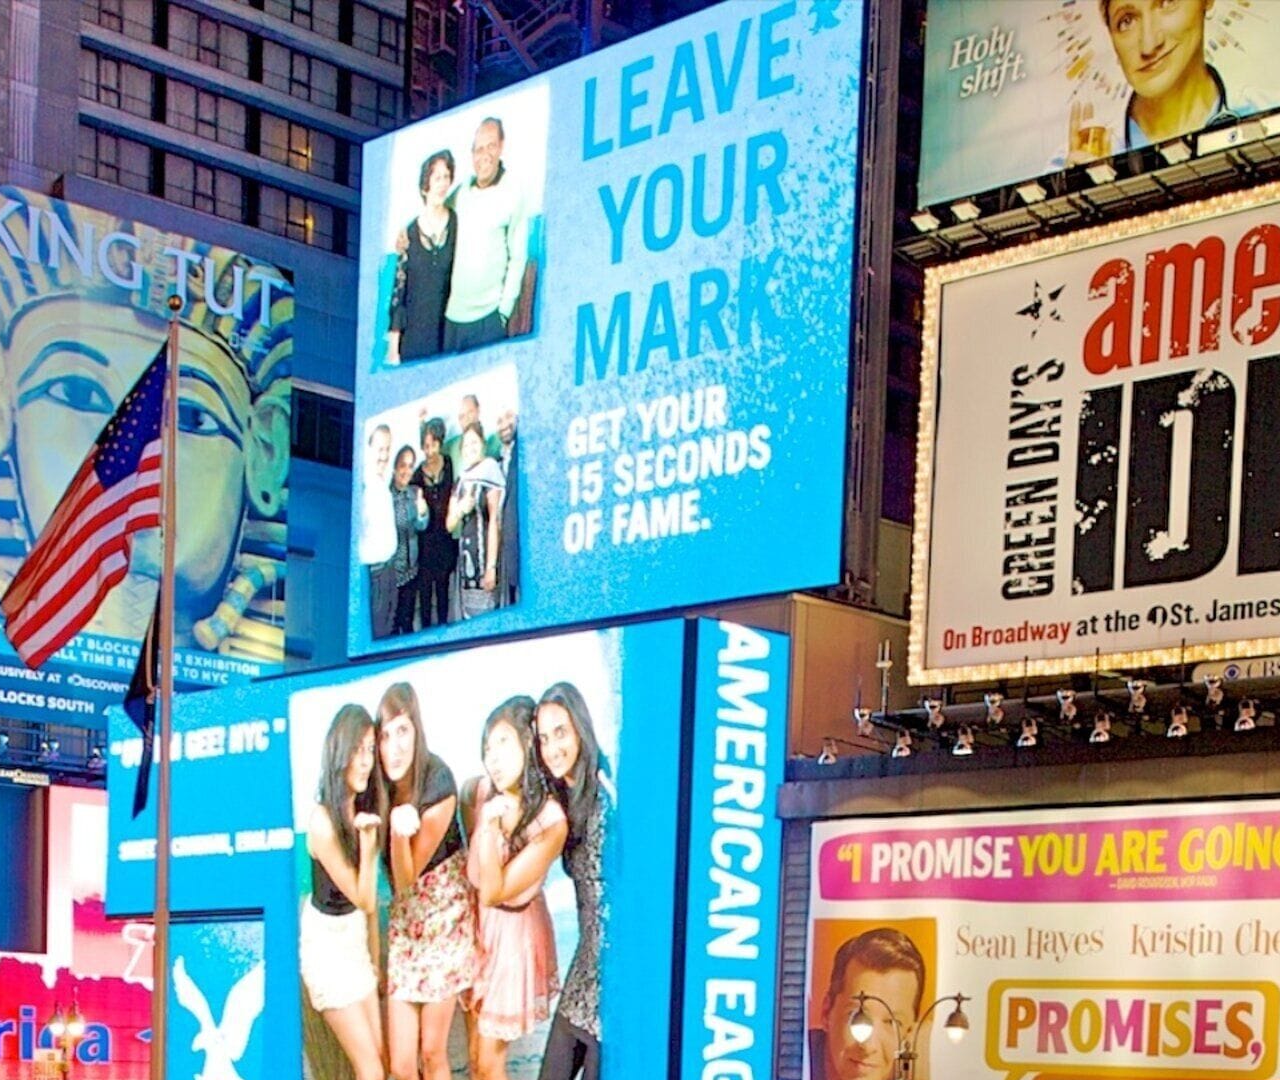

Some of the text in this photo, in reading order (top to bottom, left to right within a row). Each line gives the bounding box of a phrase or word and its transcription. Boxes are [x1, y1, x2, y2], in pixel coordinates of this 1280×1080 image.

[948, 25, 1015, 71] Holy
[960, 51, 1027, 99] shift.
[598, 129, 791, 266] YOUR
[162, 246, 295, 328] TUT
[573, 256, 778, 388] MARK
[566, 384, 730, 461] GET YOUR
[565, 425, 772, 508] 15 SECONDS
[1001, 357, 1066, 602] GREEN DAY'S
[563, 488, 711, 556] OF FAME.
[943, 628, 967, 651] On
[970, 621, 1072, 648] Broadway
[1076, 614, 1099, 637] at
[1104, 609, 1141, 633] the
[1170, 603, 1201, 627] St.
[46, 672, 61, 684] AT
[80, 650, 115, 667] TIME
[185, 654, 261, 677] EXHIBITION
[200, 669, 230, 685] NYC
[47, 694, 95, 715] SOUTH
[706, 621, 772, 961] AMERICAN
[870, 835, 1014, 884] PROMISE
[1018, 831, 1088, 878] YOU
[1094, 828, 1169, 877] ARE
[954, 920, 1017, 960] Sean
[1025, 921, 1106, 963] Hayes
[1130, 919, 1224, 958] Kristin
[1005, 996, 1263, 1065] PROMISES,
